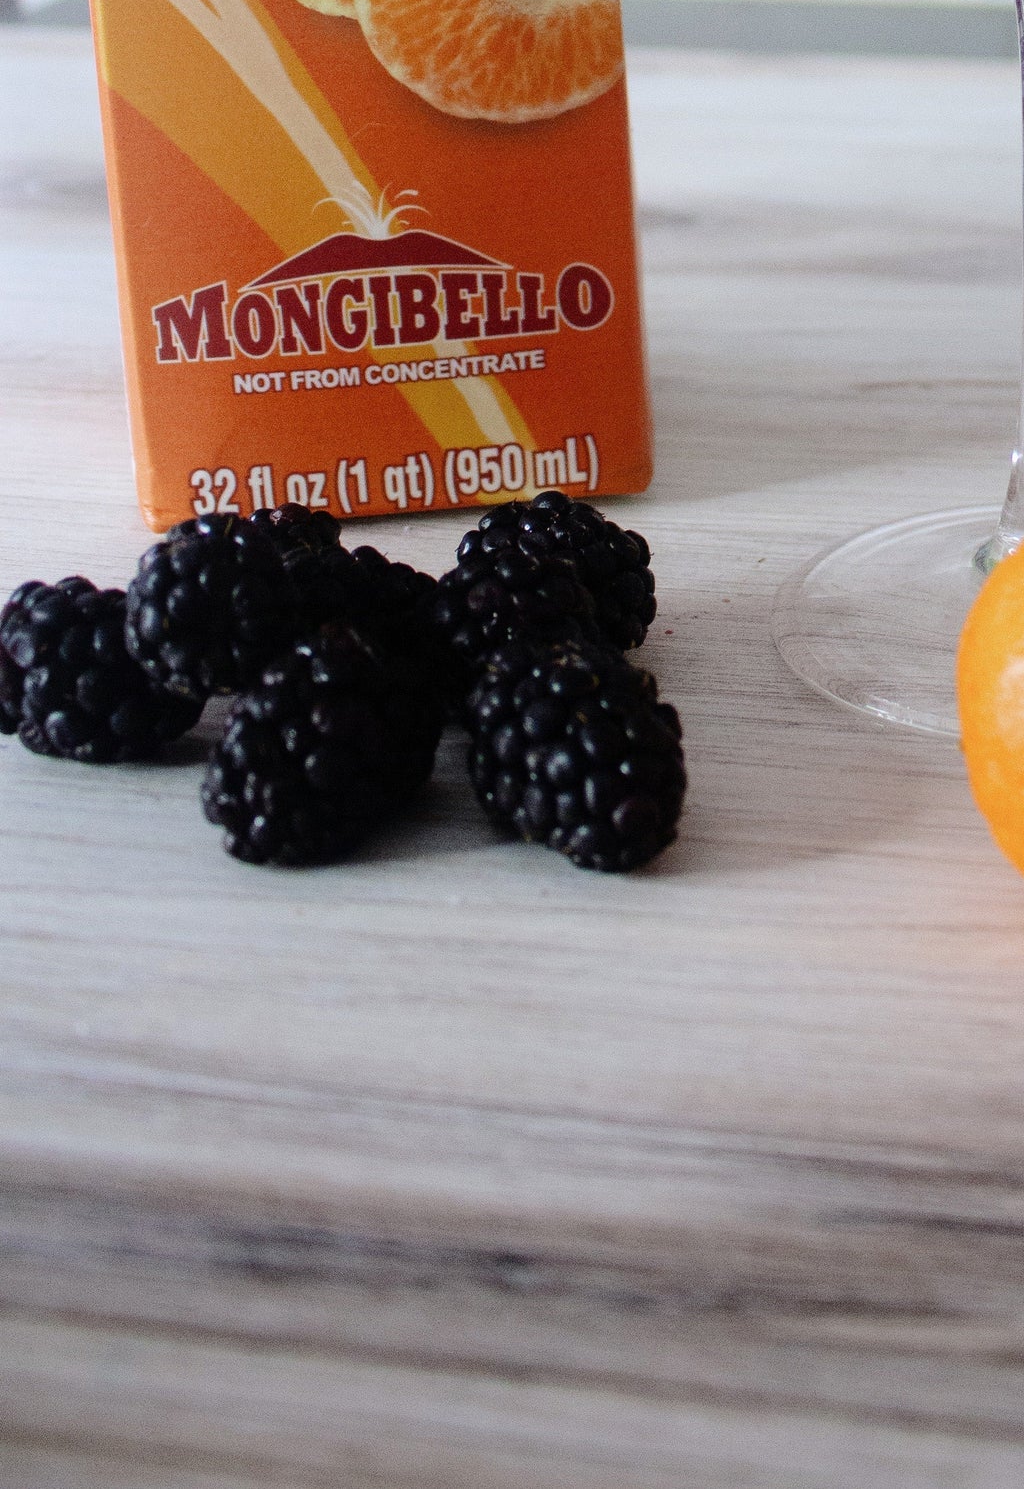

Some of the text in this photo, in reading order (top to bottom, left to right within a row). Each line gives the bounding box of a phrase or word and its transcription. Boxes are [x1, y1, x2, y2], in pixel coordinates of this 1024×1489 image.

[153, 262, 614, 364] MONGIBELLO
[233, 348, 546, 394] NOT FROM CONCENTRATE
[190, 434, 599, 516] 32 fl oz (1 qt) (950 mL)
